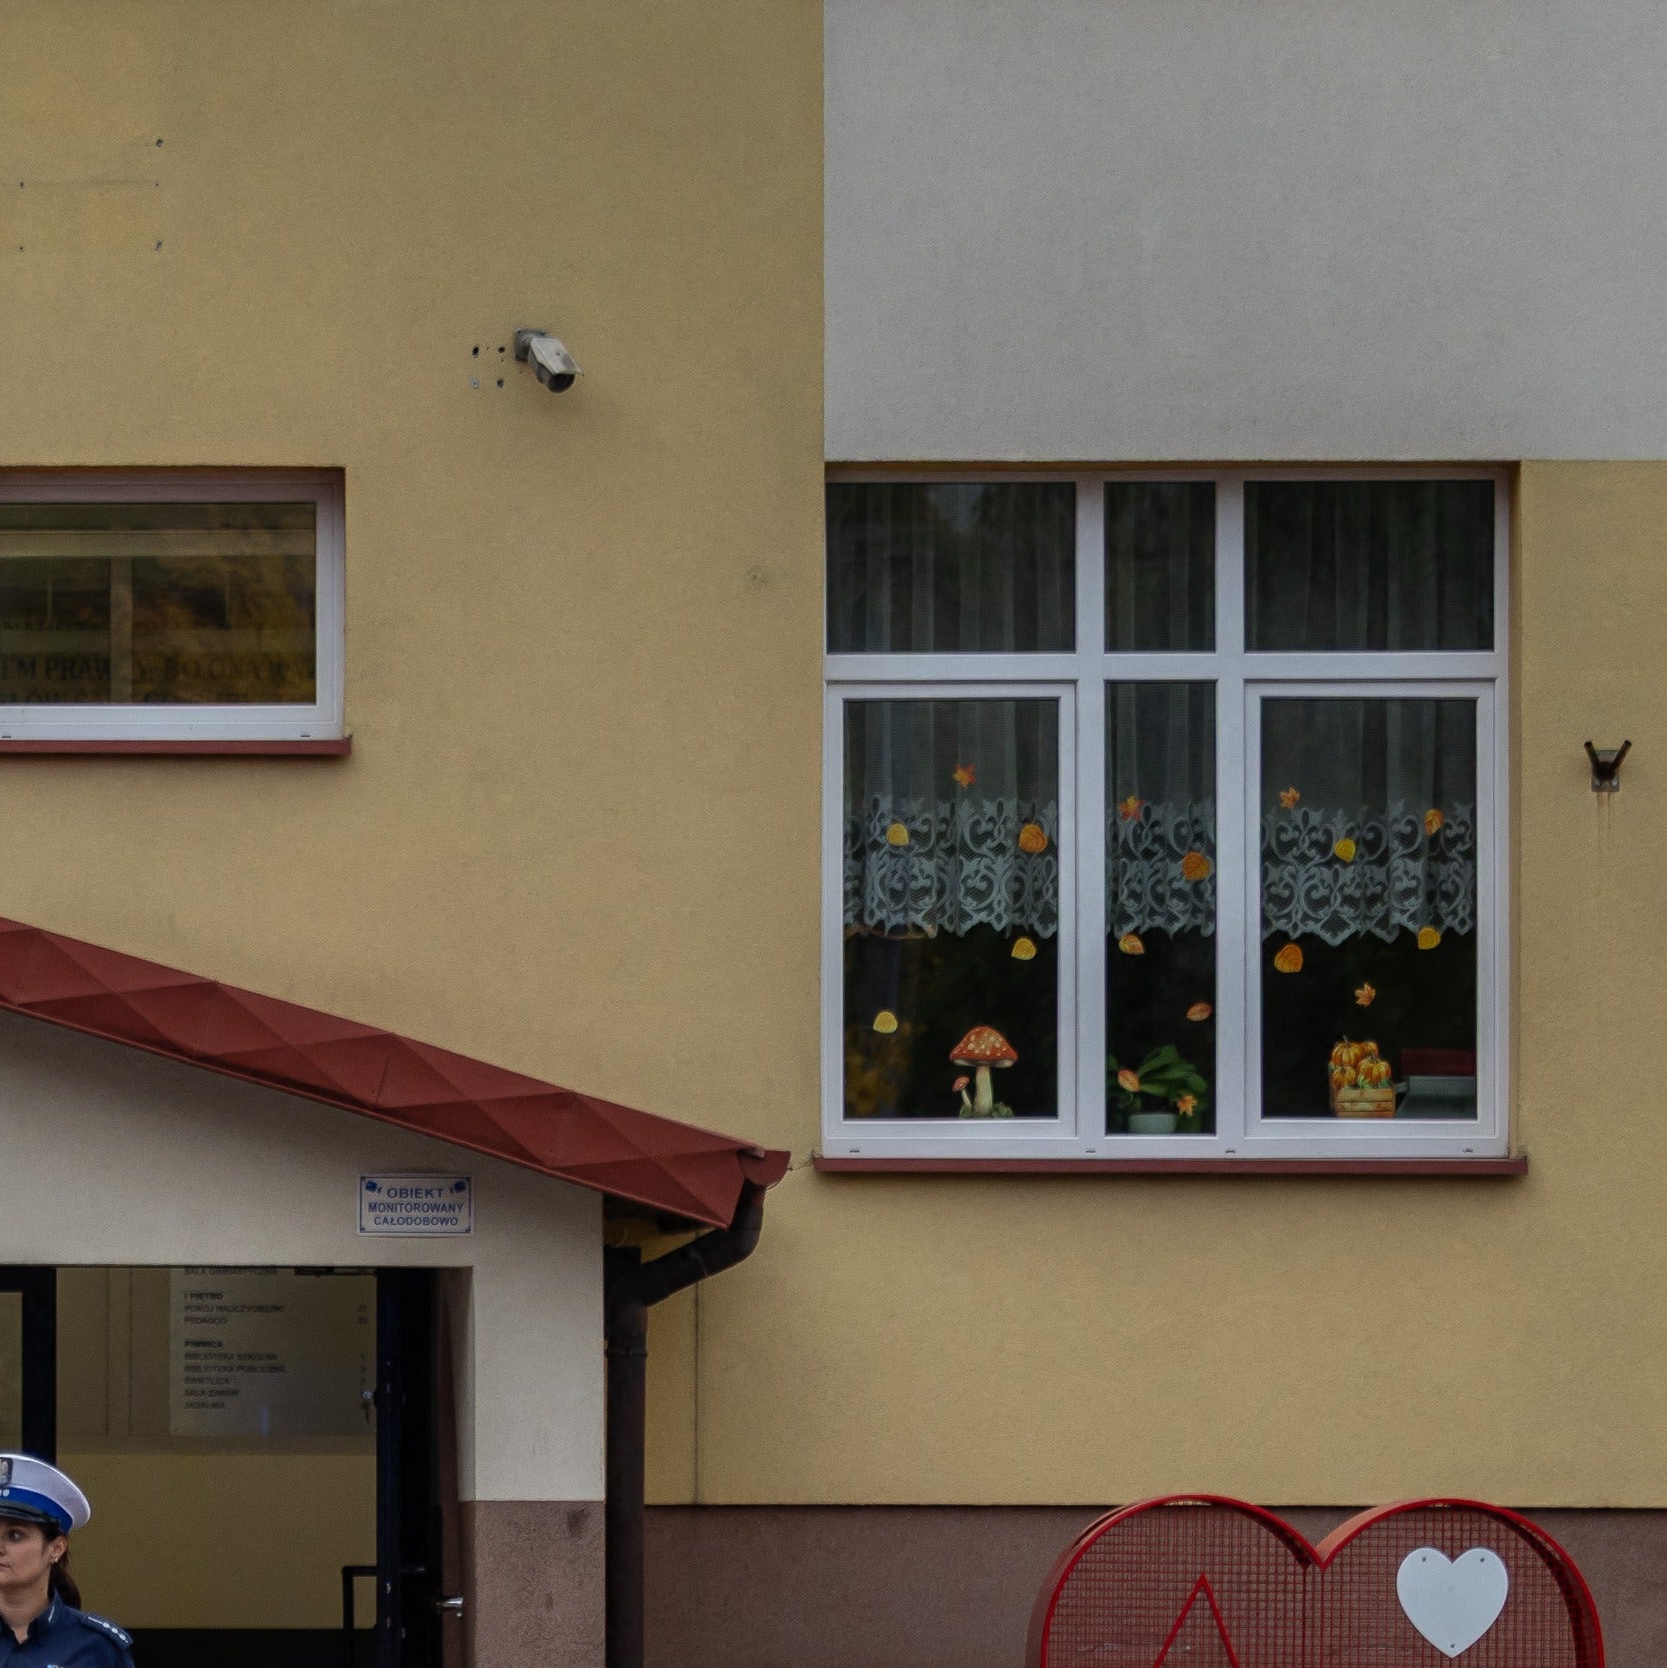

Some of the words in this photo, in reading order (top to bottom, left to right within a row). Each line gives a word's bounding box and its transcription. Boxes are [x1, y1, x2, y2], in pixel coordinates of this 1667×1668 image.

[387, 1188, 444, 1199] OBIEKT
[368, 1203, 463, 1213] MONITOROWANY
[373, 1216, 458, 1226] CAŁODOBOWO
